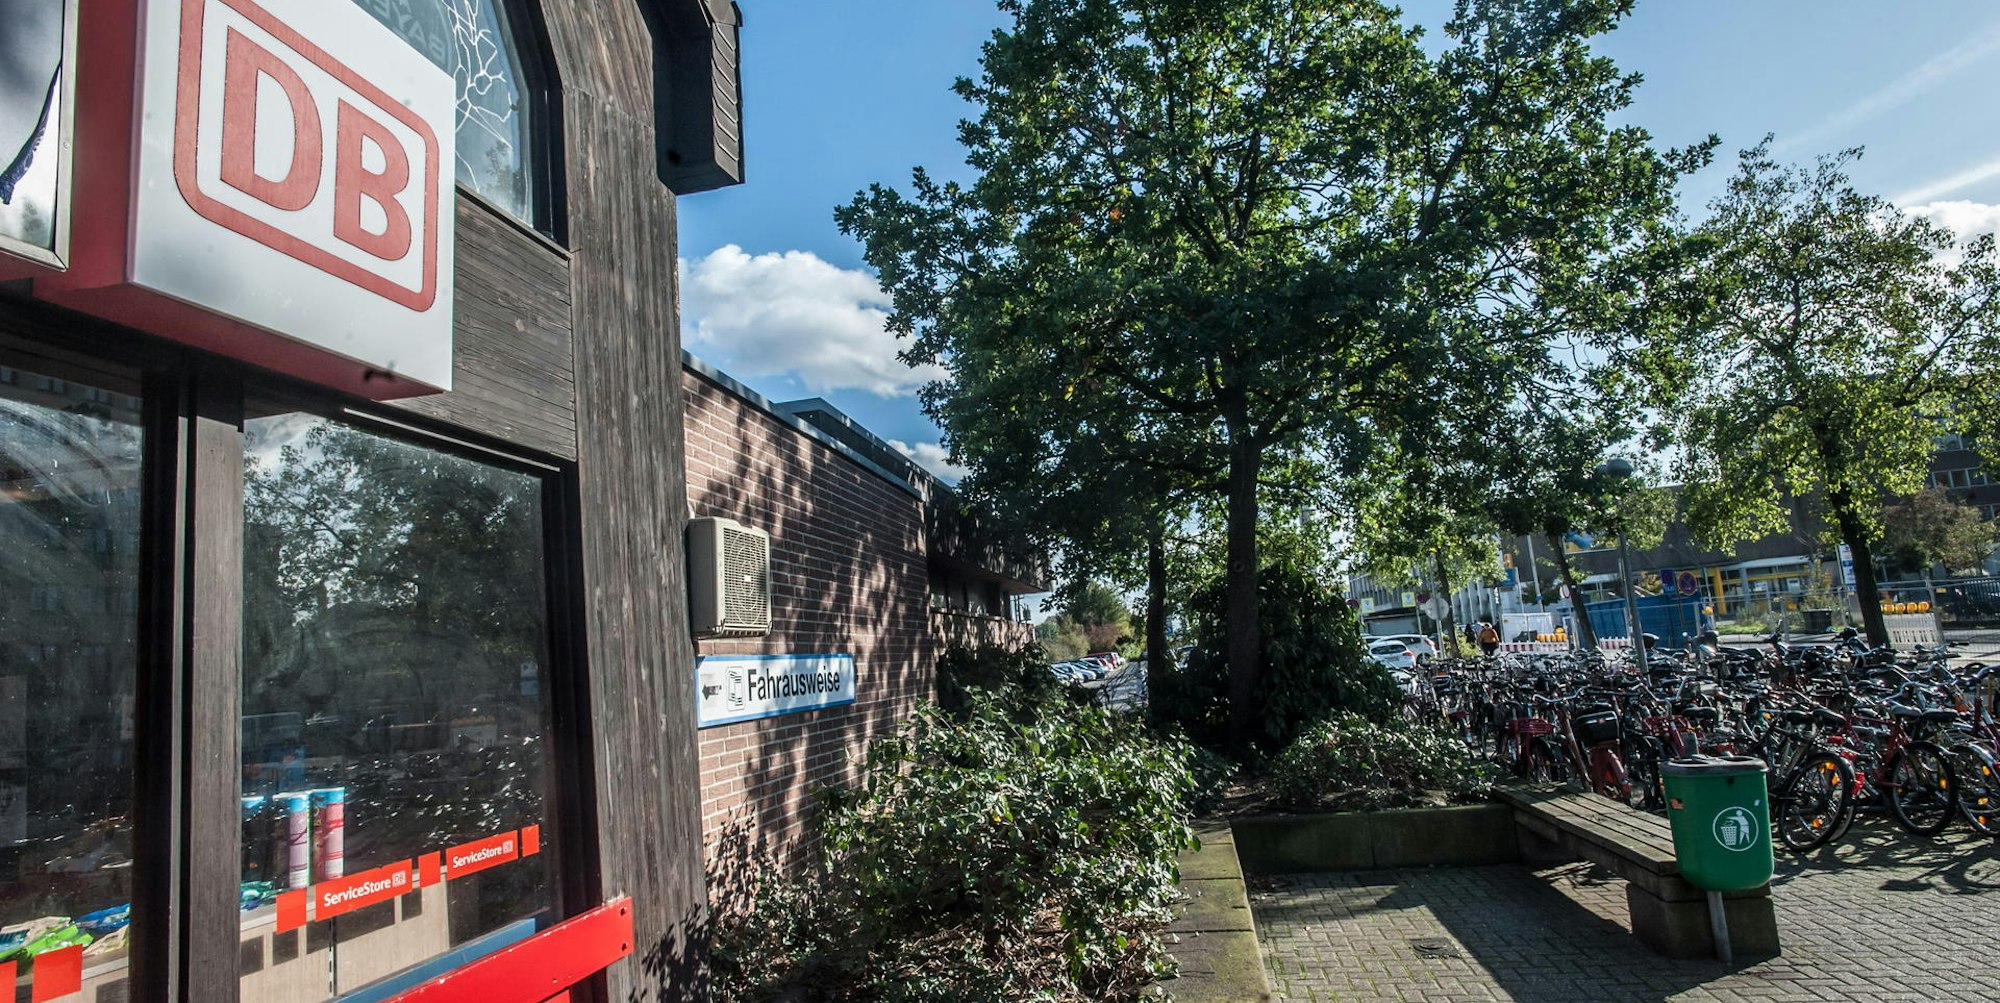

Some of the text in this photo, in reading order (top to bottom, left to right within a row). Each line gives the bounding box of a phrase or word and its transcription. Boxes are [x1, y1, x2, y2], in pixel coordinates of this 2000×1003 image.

[221, 25, 412, 261] DB
[748, 665, 840, 701] Fahrausweise
[453, 846, 502, 869] ServiceStore
[324, 878, 391, 907] ServiceStore
[392, 870, 406, 887] DB
